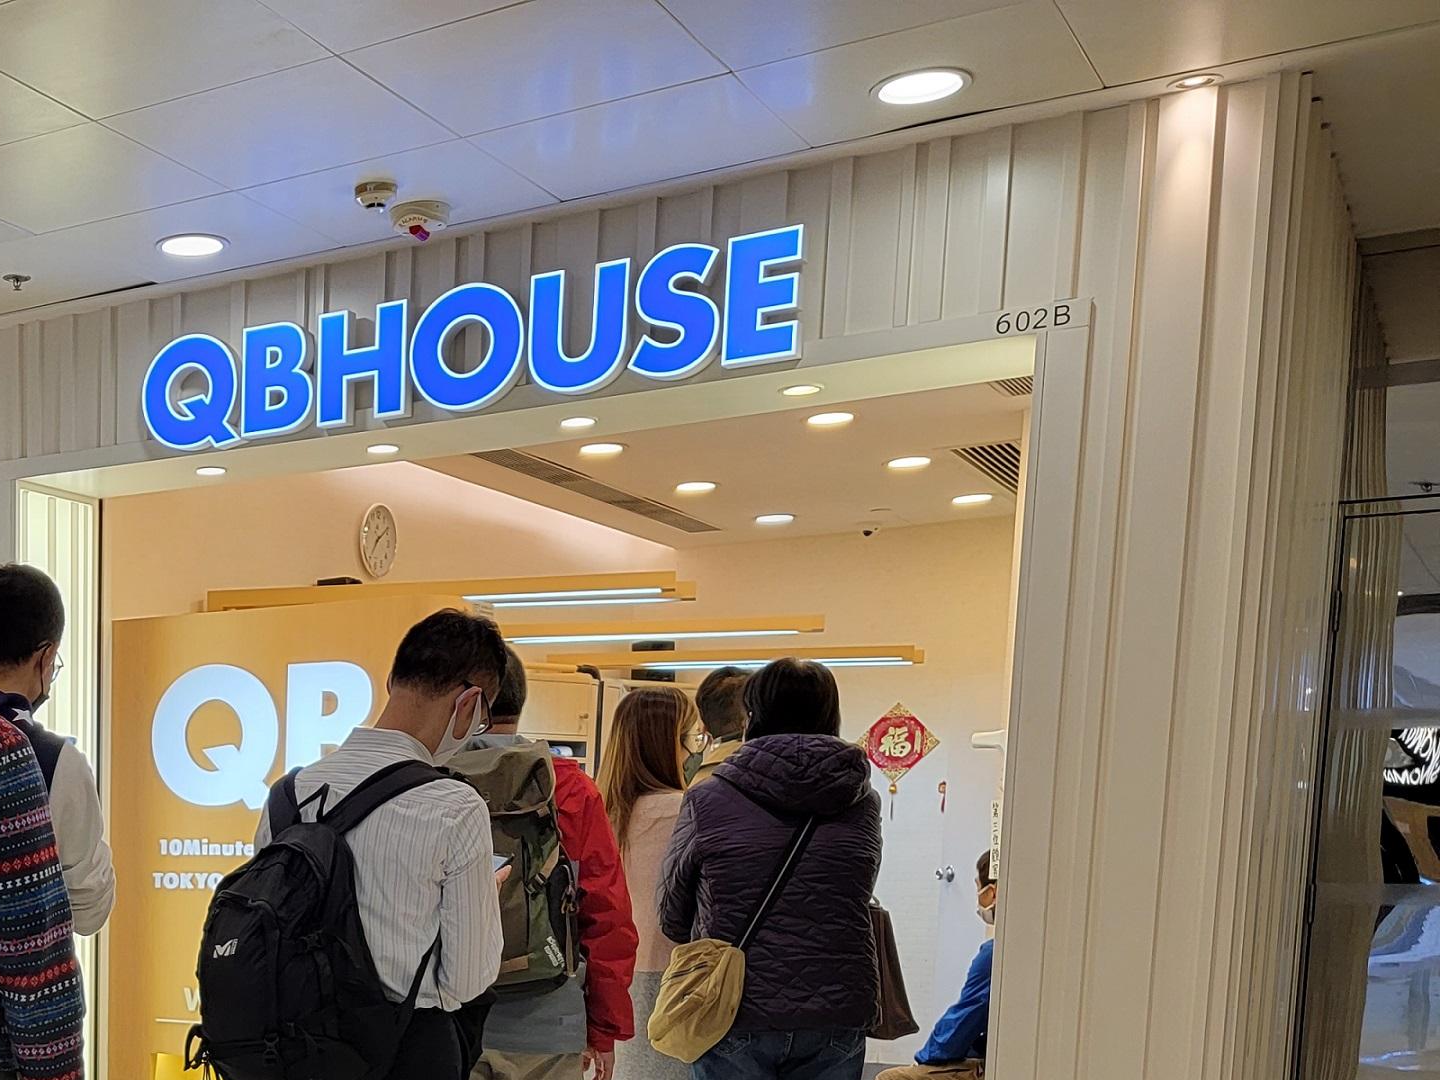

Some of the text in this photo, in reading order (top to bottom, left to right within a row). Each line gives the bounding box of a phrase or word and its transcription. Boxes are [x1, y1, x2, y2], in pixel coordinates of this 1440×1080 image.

[996, 305, 1071, 334] 602B
[142, 224, 805, 450] QBHOUSE
[152, 661, 372, 810] QB
[879, 726, 912, 757] 福
[152, 872, 224, 889] TOKYO
